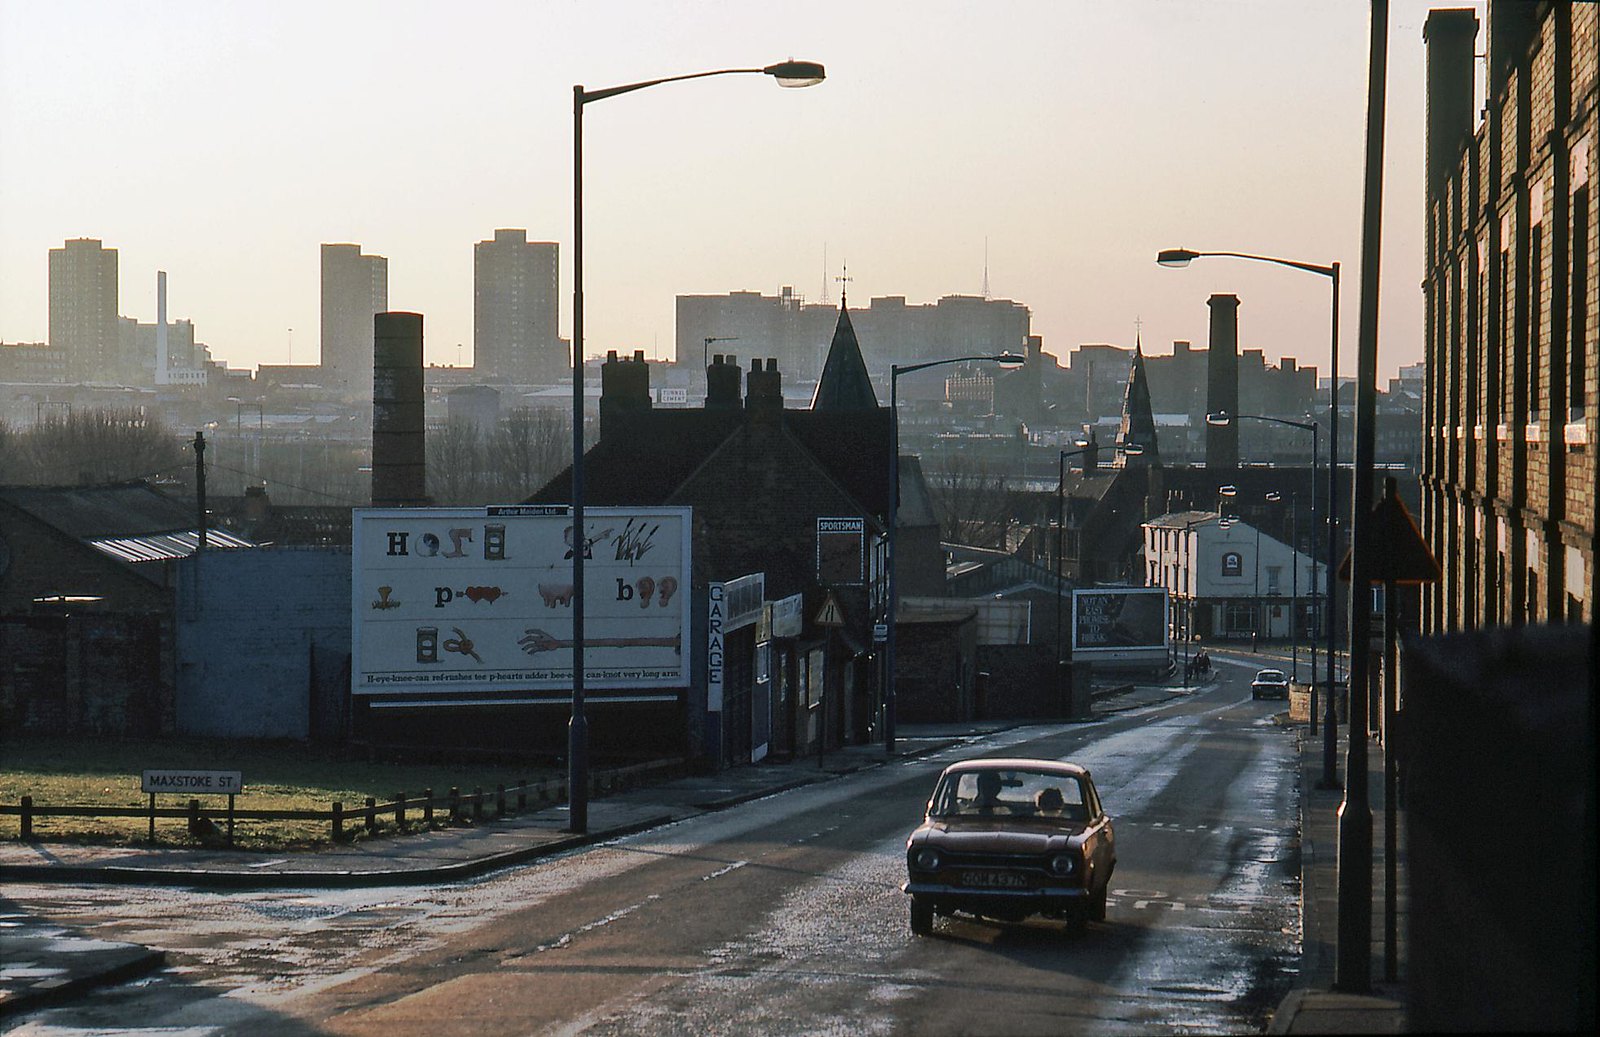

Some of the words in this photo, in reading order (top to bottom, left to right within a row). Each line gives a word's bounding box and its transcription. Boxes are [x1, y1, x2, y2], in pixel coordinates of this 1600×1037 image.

[820, 521, 861, 531] SPORTSMAN
[386, 532, 409, 556] H
[709, 586, 723, 684] GARAGE
[489, 672, 523, 682] p-hearts
[525, 671, 548, 679] udder
[623, 670, 641, 679] very
[642, 669, 660, 678] long
[150, 775, 212, 787] MAXSTOKE
